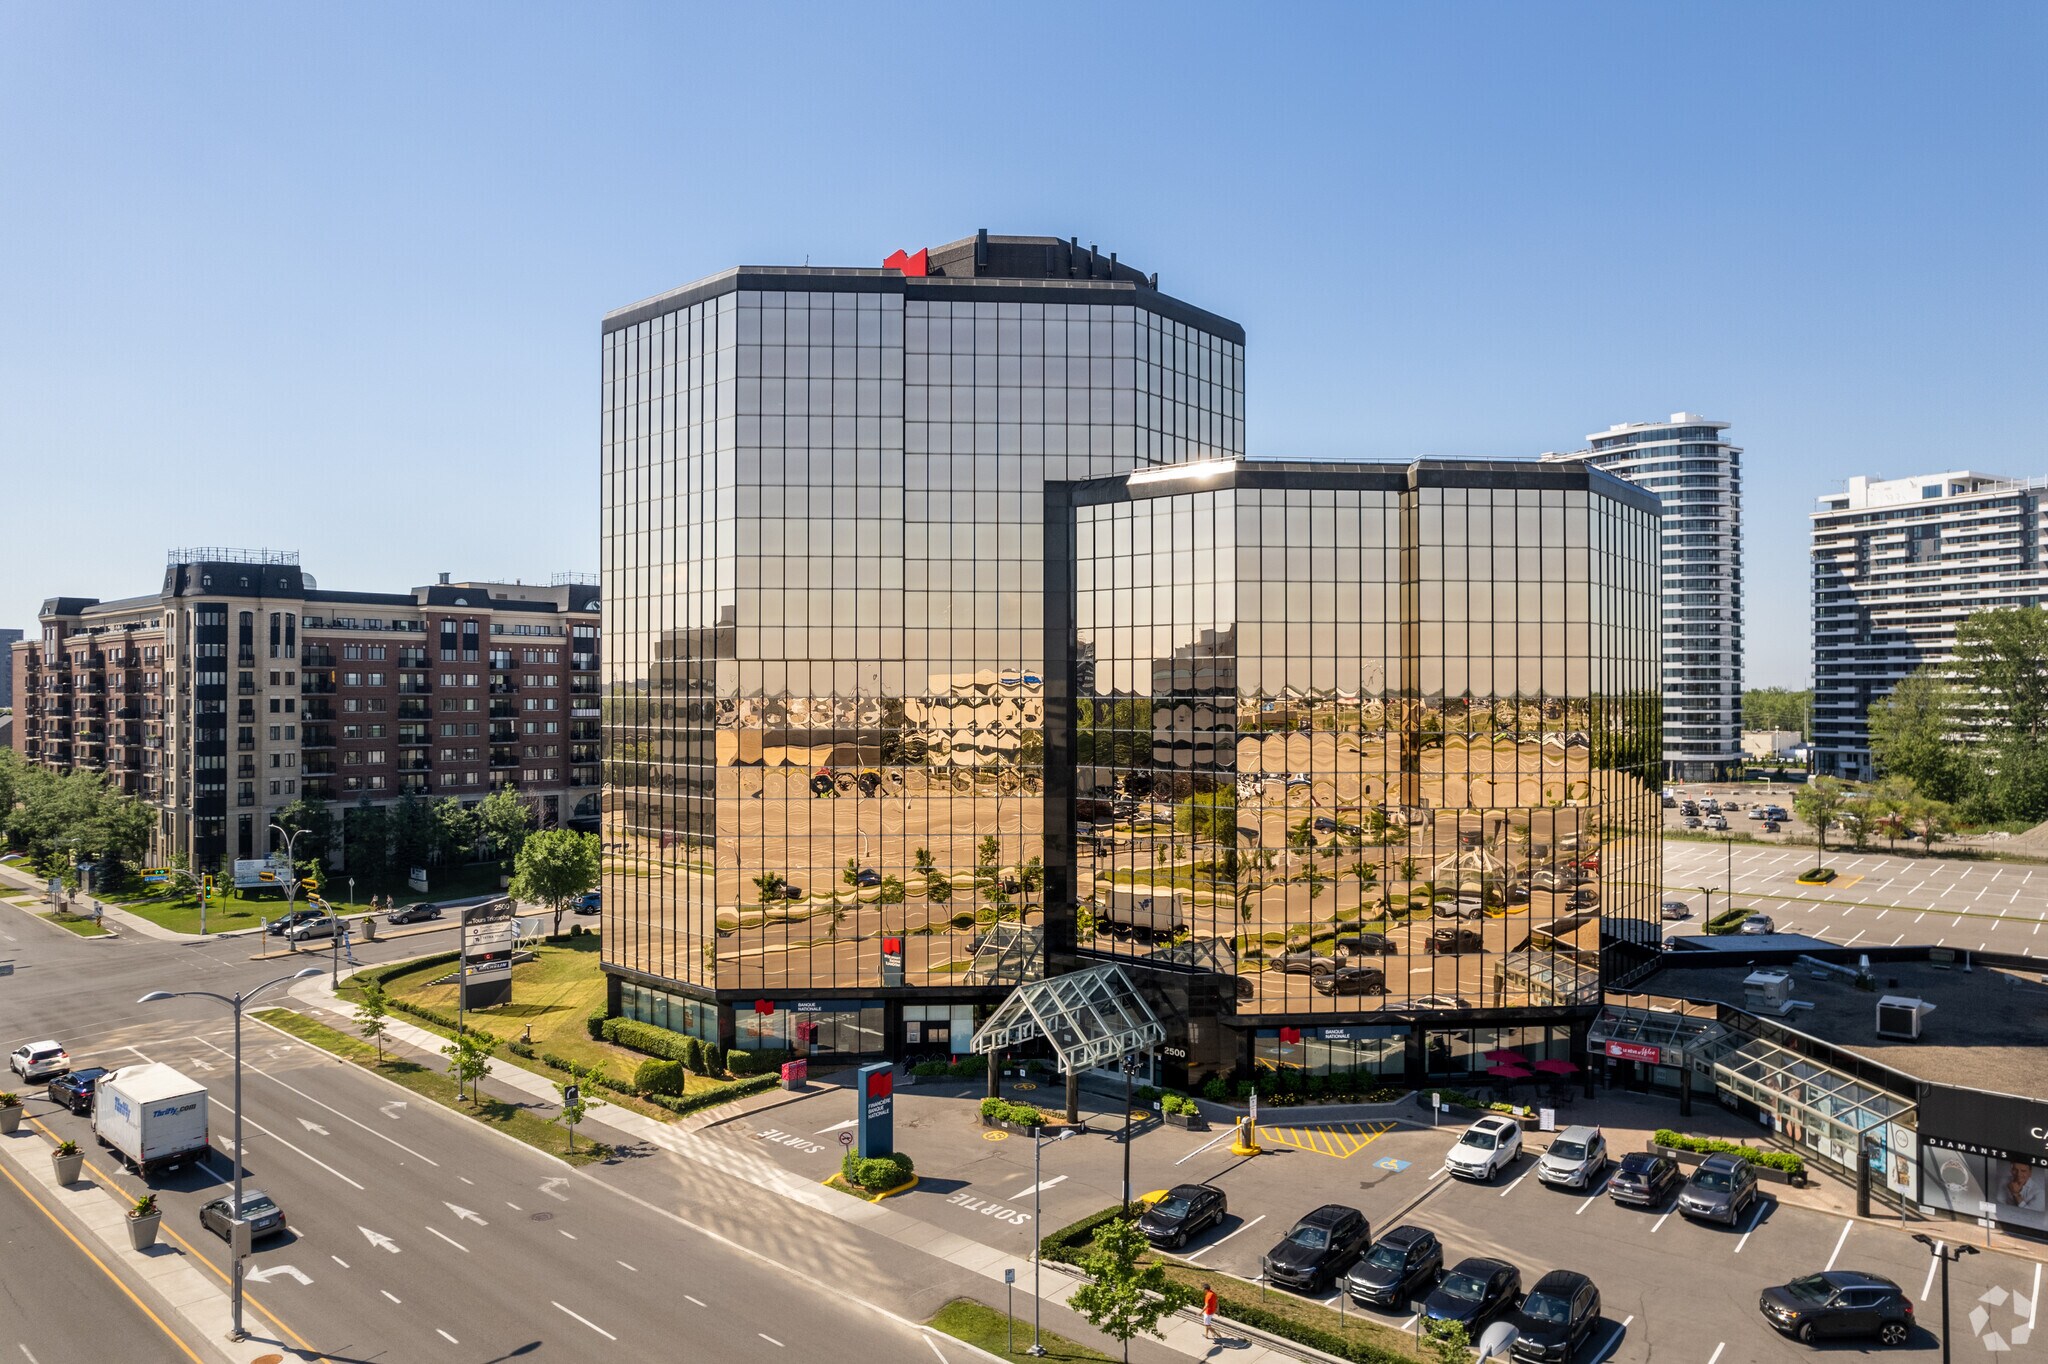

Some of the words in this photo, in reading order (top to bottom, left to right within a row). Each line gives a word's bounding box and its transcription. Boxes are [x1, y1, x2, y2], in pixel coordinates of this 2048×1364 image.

[494, 903, 510, 911] 2500
[472, 916, 486, 924] Tours
[1164, 1047, 1186, 1058] 2500
[868, 1105, 884, 1114] BANQUE
[868, 1109, 890, 1119] NATIONALE
[757, 1128, 826, 1153] SORTIE
[1929, 1138, 2007, 1158] DIAMANTS
[946, 1193, 1032, 1225] SORTIE
